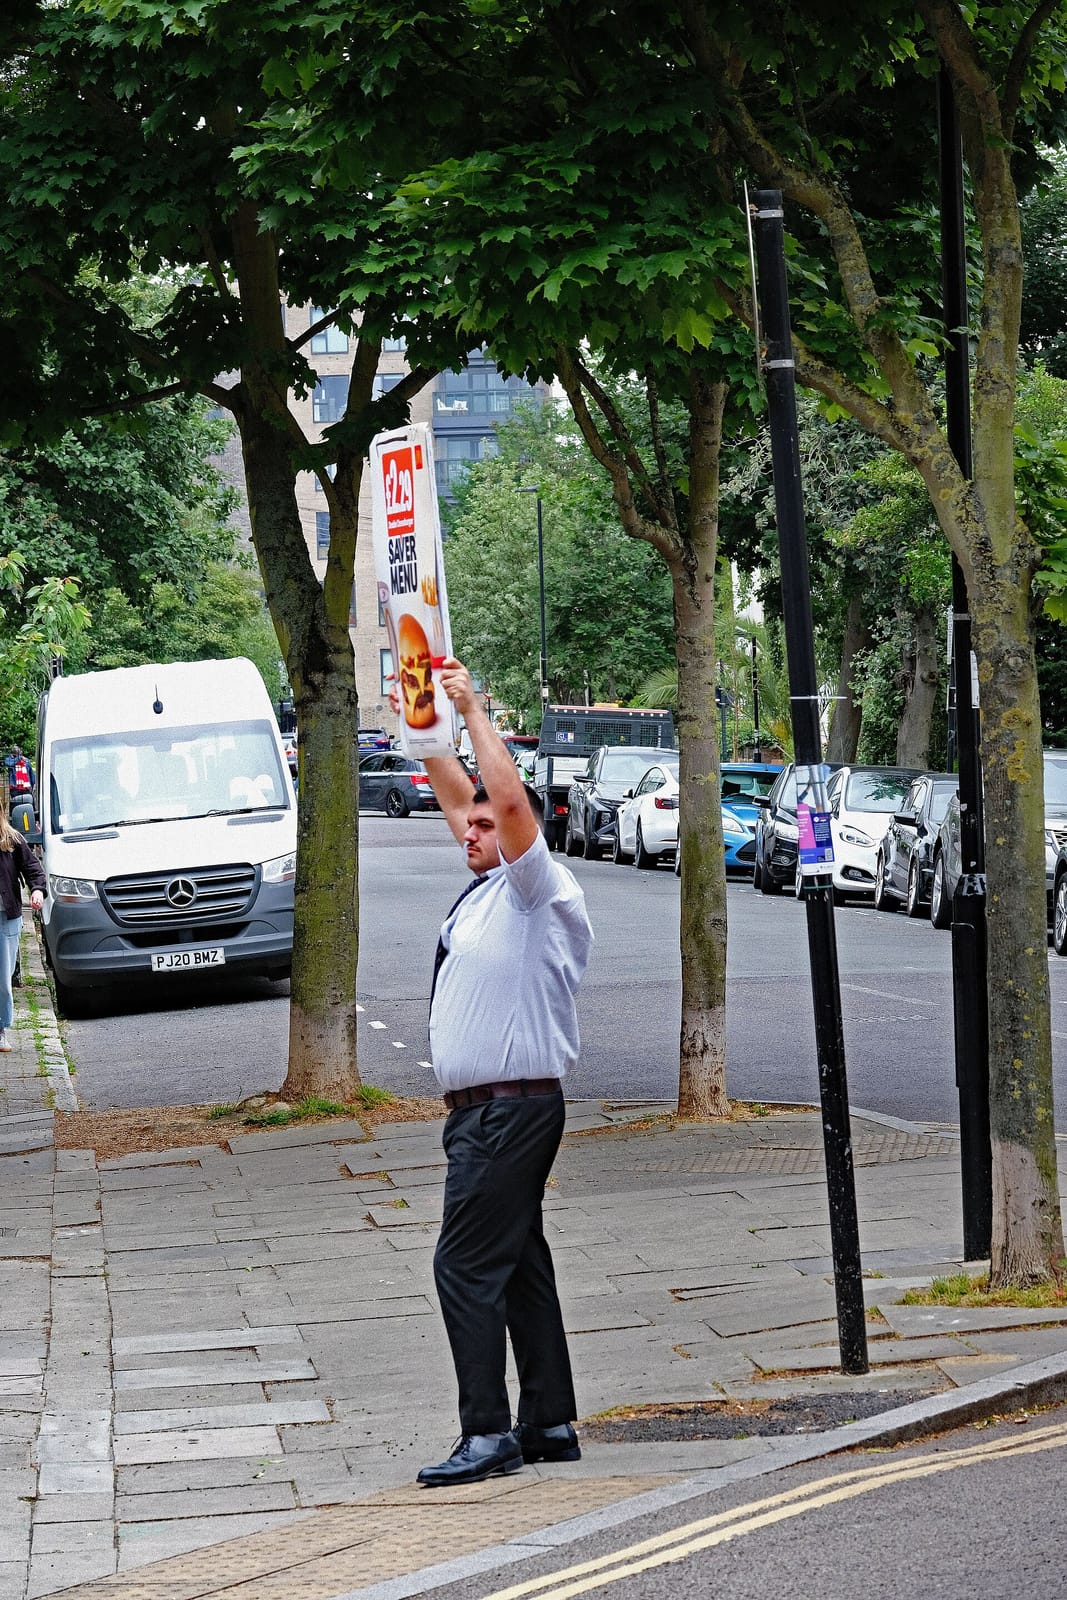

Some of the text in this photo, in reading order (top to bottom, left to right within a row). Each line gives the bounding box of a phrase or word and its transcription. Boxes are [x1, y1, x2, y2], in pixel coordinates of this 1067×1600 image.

[388, 535, 417, 565] SAVER
[390, 562, 418, 595] MENU
[157, 951, 219, 968] PJ20 BMZ
